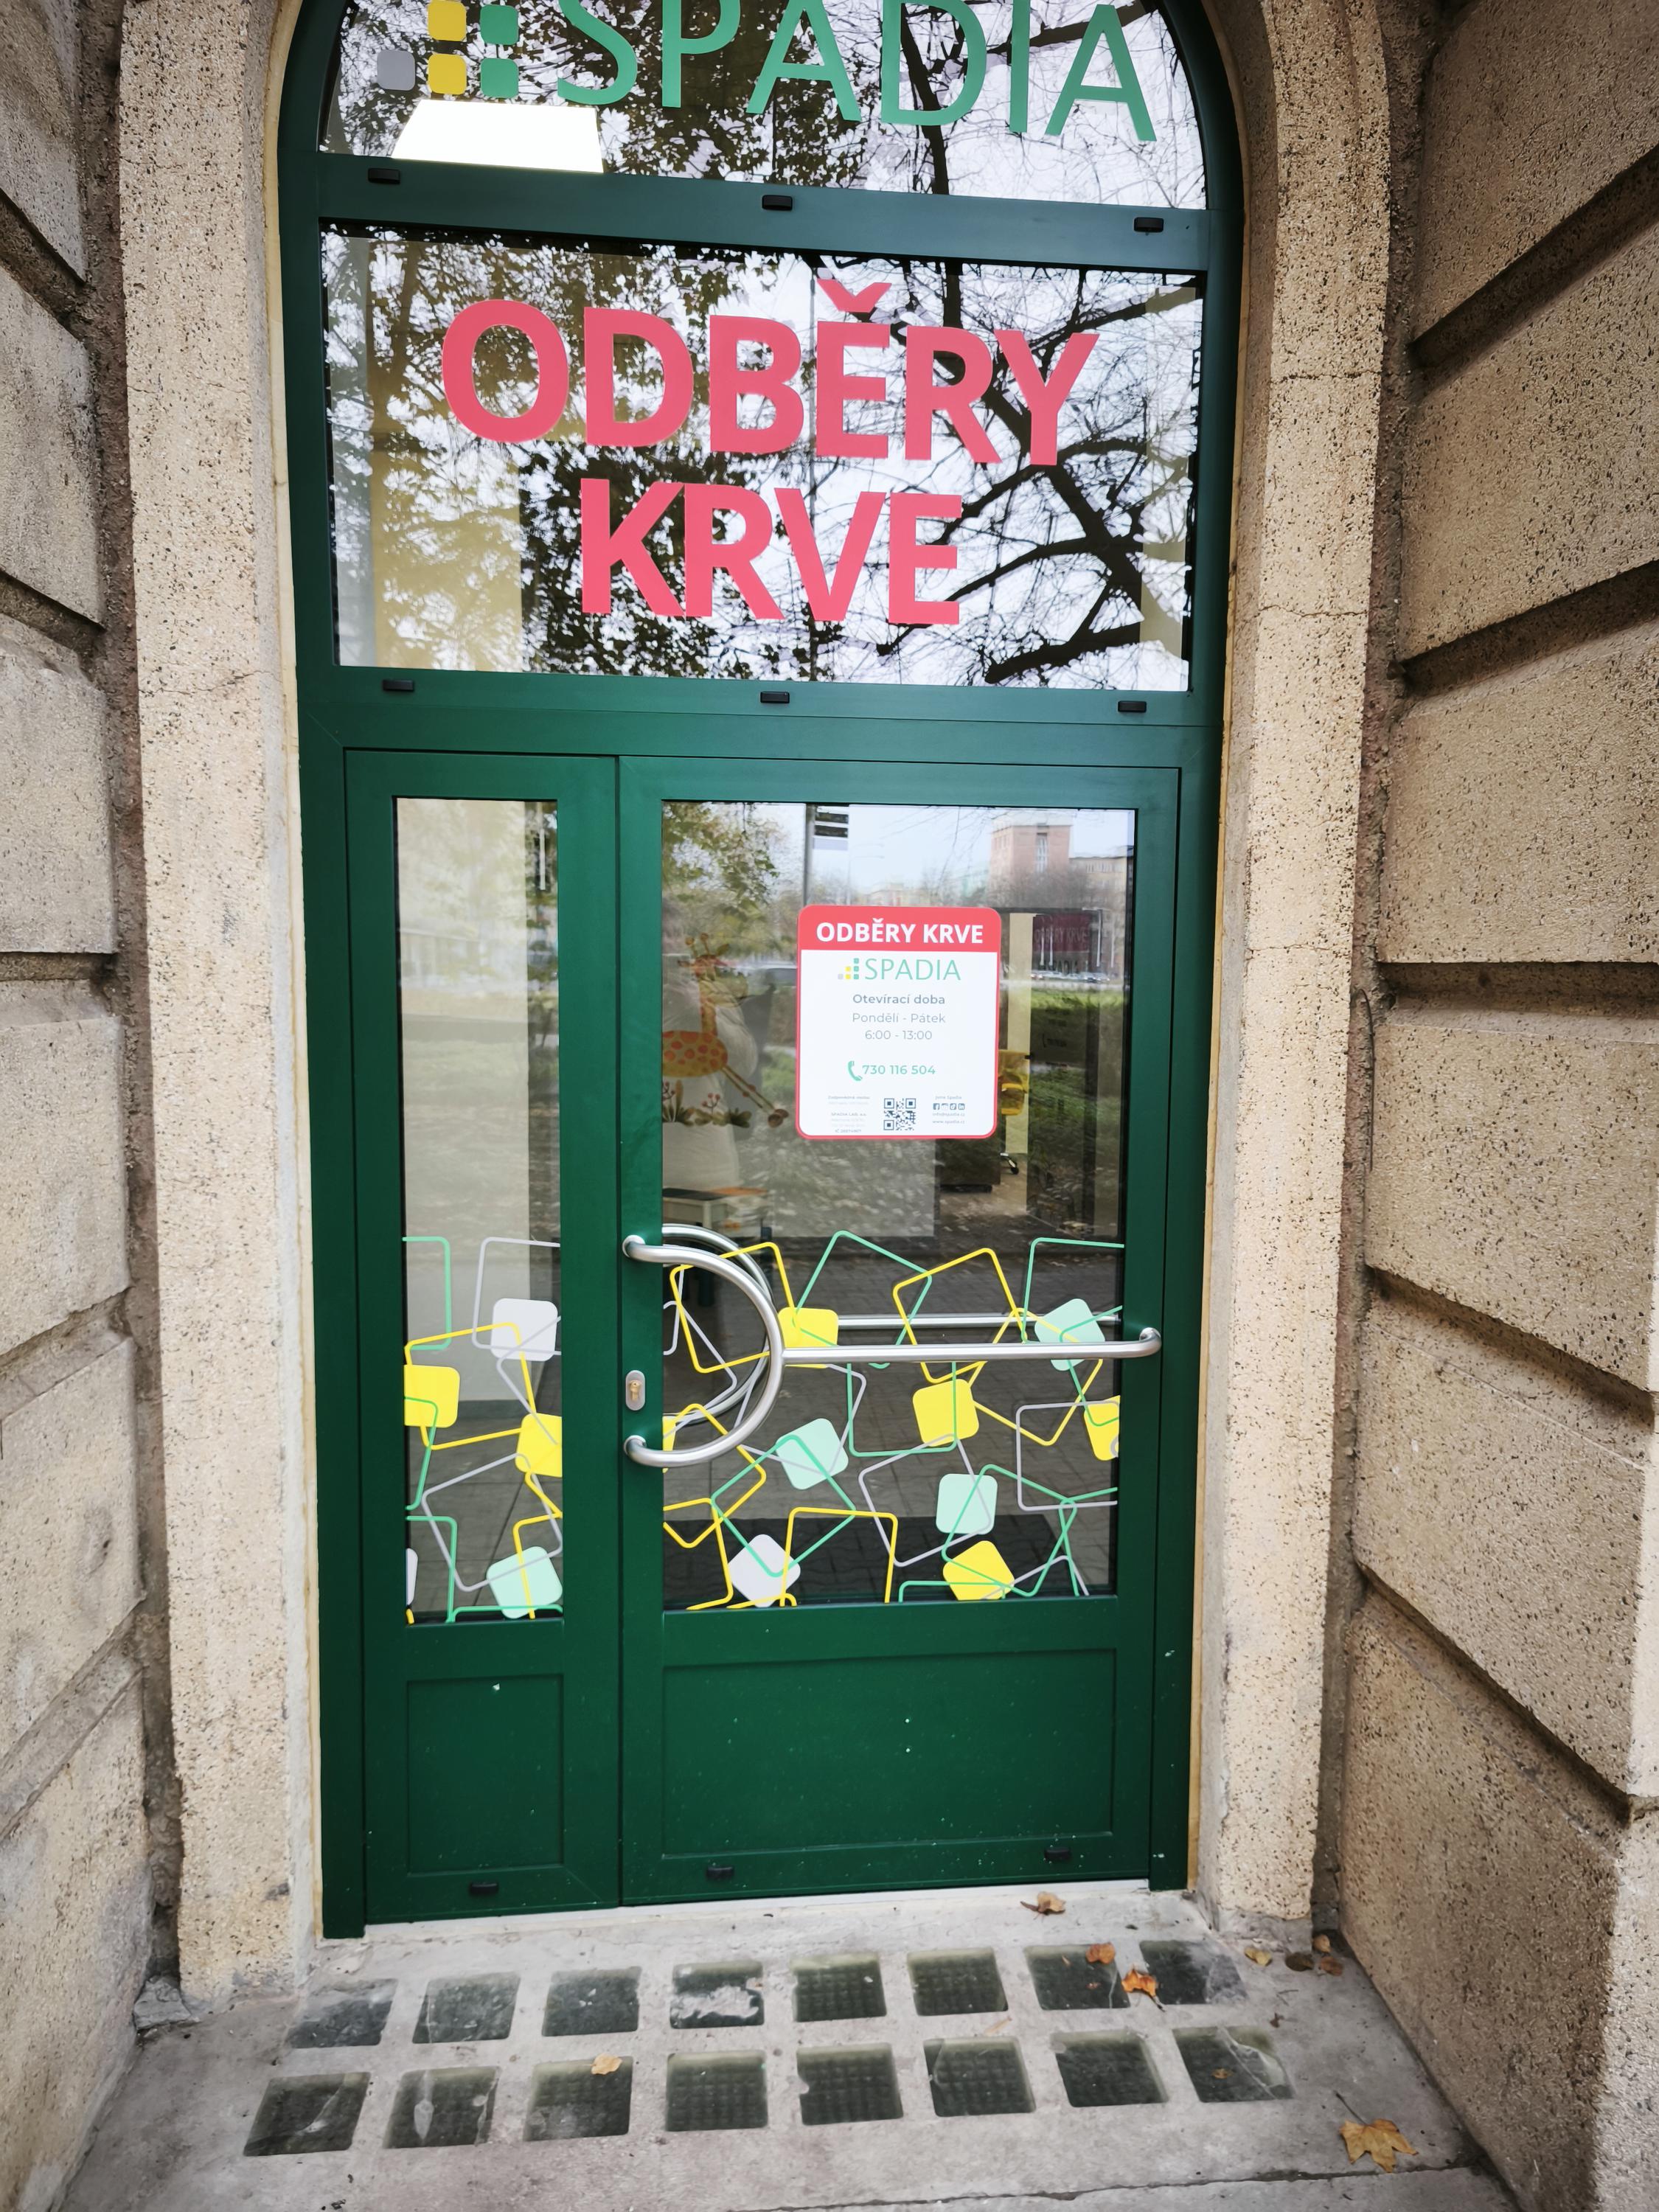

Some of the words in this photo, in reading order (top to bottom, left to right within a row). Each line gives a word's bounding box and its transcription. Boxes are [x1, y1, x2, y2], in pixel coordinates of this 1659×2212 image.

[557, 0, 1157, 142] SPADIA
[442, 277, 1100, 467] ODBĚRY
[580, 477, 962, 625] KRVE
[816, 918, 917, 943] ODBĚRY
[922, 923, 984, 945] KRVE
[864, 958, 961, 981] SPADIA
[852, 994, 911, 1004] Otevírací
[914, 994, 945, 1004] doba
[852, 1012, 900, 1023] Pondělí
[911, 1012, 946, 1023] Pátek
[865, 1030, 891, 1040] 6:00
[902, 1030, 932, 1040] 13:00
[862, 1065, 886, 1074] 730
[889, 1065, 908, 1074] 116
[911, 1065, 936, 1074] 504
